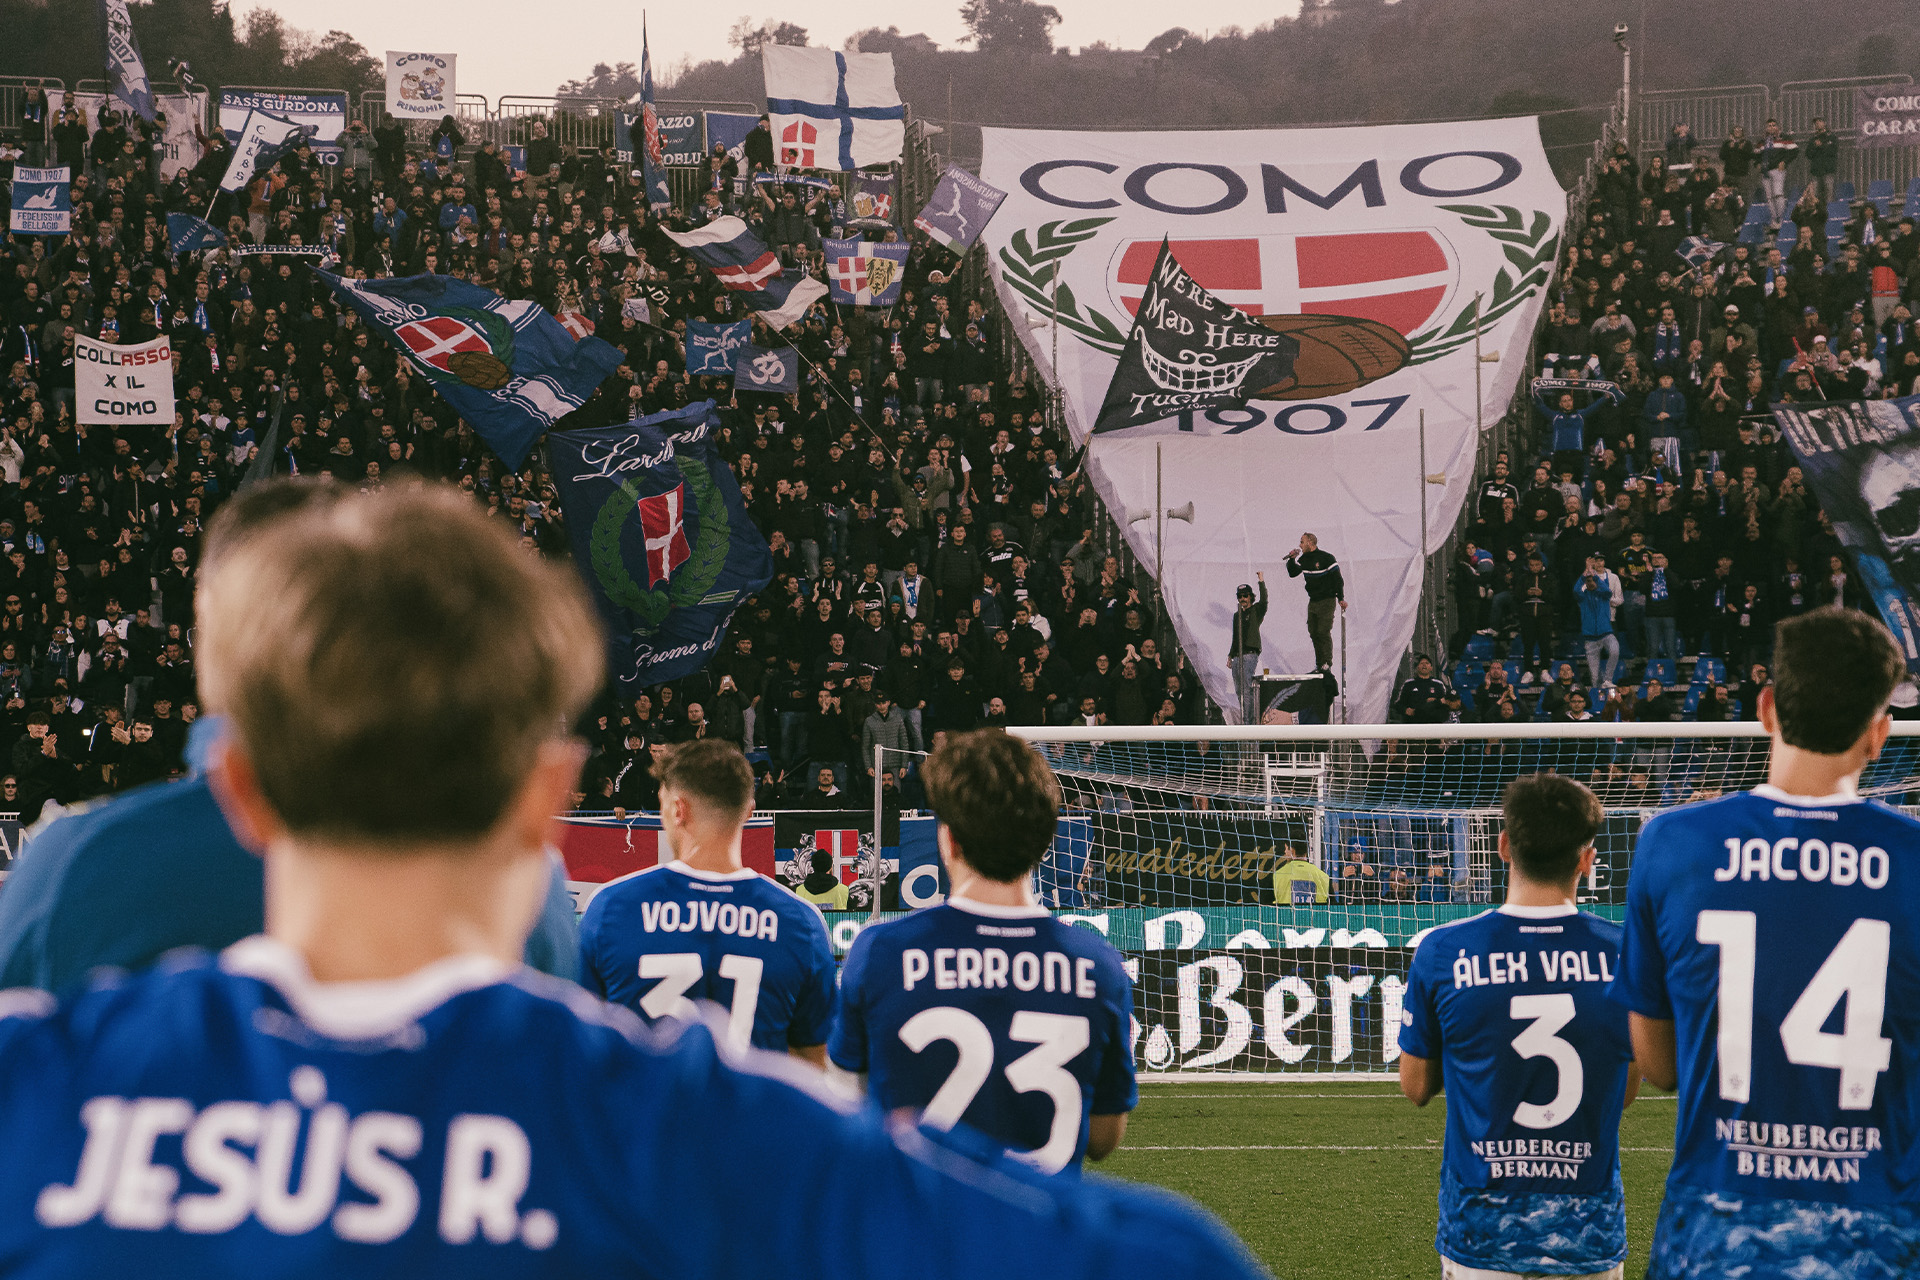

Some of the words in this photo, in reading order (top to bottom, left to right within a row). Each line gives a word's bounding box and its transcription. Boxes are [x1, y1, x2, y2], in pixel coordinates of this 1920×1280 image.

[395, 53, 447, 69] COMO
[223, 94, 260, 108] SASS
[262, 100, 340, 112] GURDONA
[396, 100, 447, 113] RINGHIA
[624, 114, 696, 129] LAZZO
[19, 169, 42, 181] COMO
[44, 169, 64, 181] 1907
[1019, 151, 1523, 215] COMO
[17, 212, 64, 222] FEDELISSIMI
[22, 221, 59, 230] BELLAGIO
[1159, 250, 1216, 311] WE'RE
[375, 303, 428, 327] COMO
[1205, 320, 1280, 351] HERE
[76, 344, 171, 367] COLLASSO
[104, 374, 117, 388] X
[126, 376, 145, 389] IL
[491, 377, 530, 400] 1907
[94, 399, 157, 415] COMO
[1178, 394, 1411, 435] 1907
[1714, 837, 1890, 889] JACOBO
[641, 900, 779, 942] VOJVODA
[903, 947, 1096, 998] PERRONE
[1453, 949, 1528, 989] ÁLEX
[1538, 951, 1620, 983] VALL
[638, 952, 764, 1050] 31
[1696, 910, 1892, 1110] 14
[1510, 993, 1584, 1129] 3
[898, 1006, 1090, 1175] 23
[1471, 1139, 1592, 1158] NEUBERGER
[1716, 1118, 1882, 1151] NEUBERGER
[35, 1065, 424, 1245] JESÚS
[439, 1114, 559, 1250] R.
[1490, 1160, 1579, 1181] BERMAN
[1737, 1152, 1860, 1183] BERMAN
